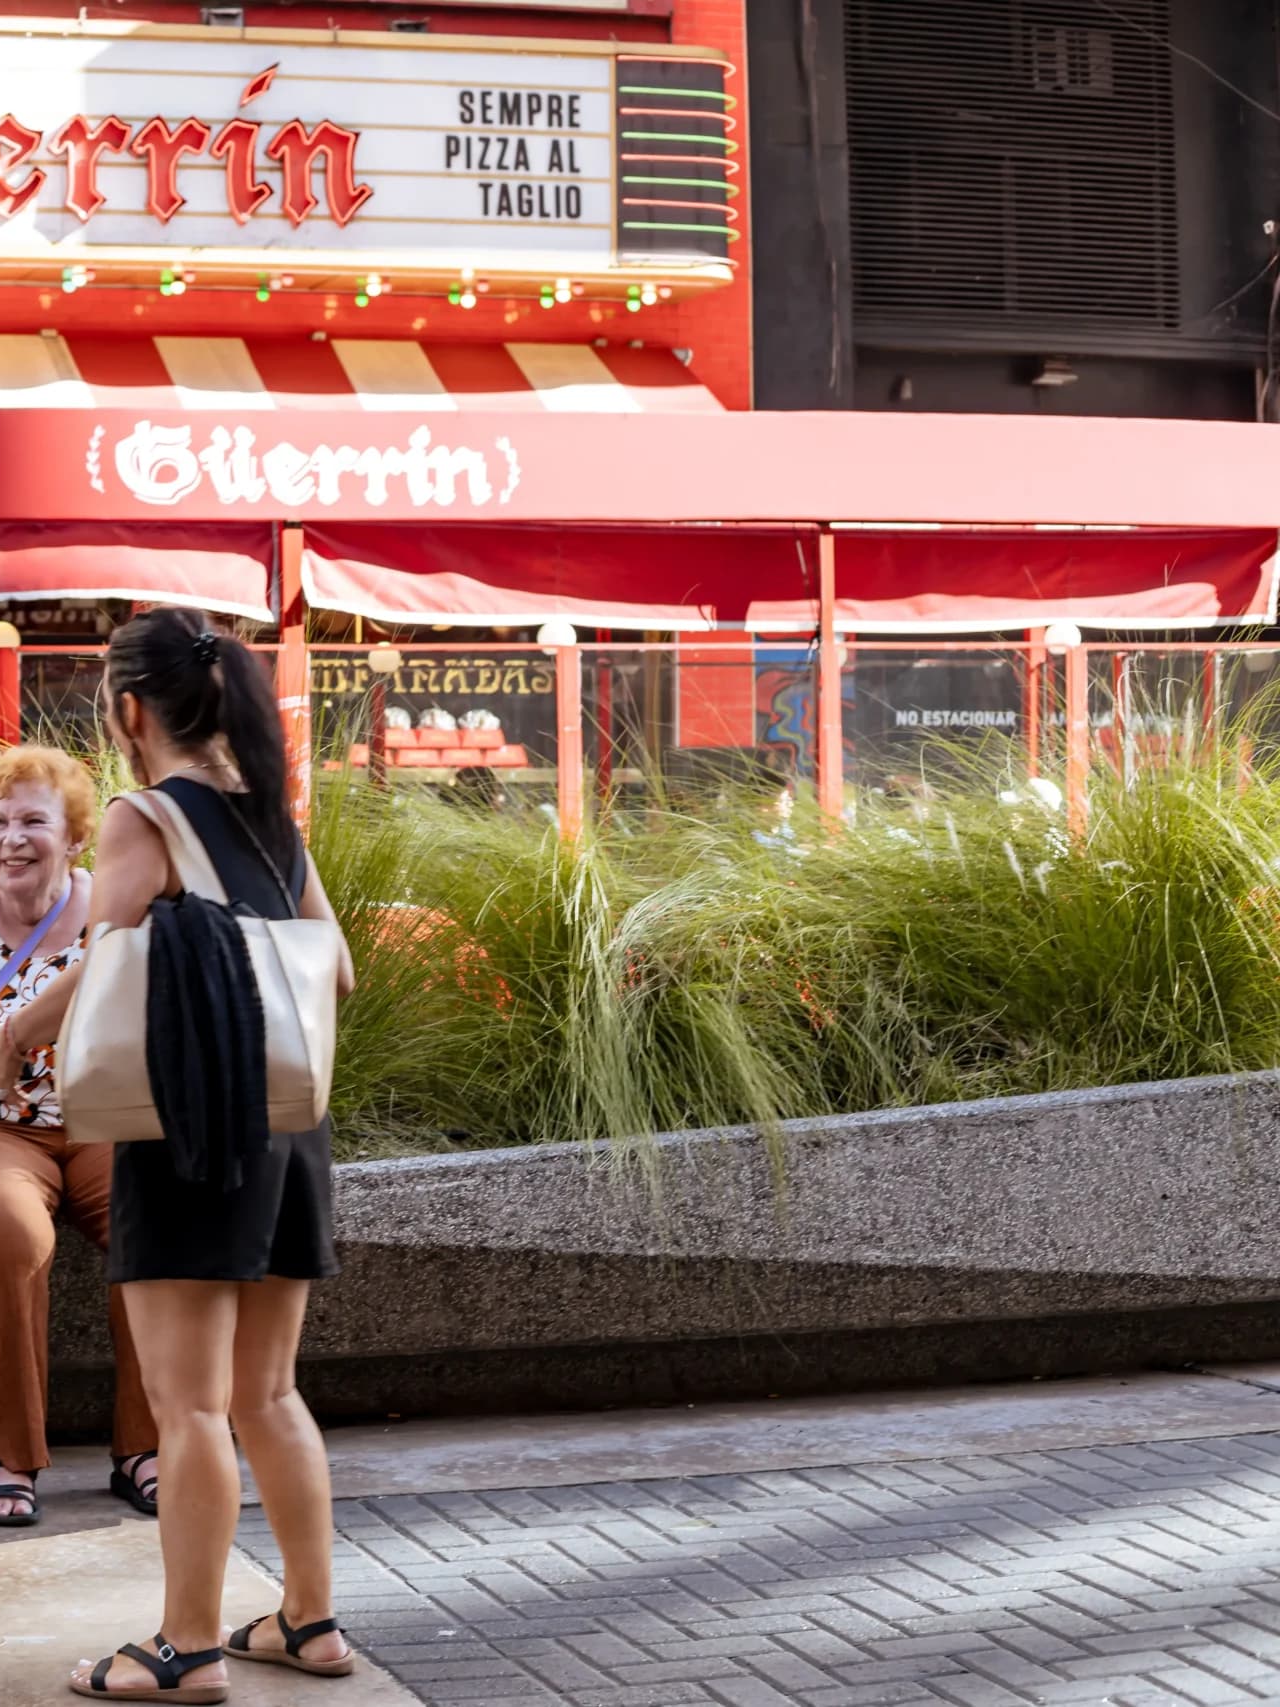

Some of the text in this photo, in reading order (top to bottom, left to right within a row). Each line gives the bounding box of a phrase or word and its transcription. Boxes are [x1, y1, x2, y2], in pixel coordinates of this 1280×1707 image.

[458, 90, 582, 129] SEMPRE
[445, 134, 582, 174] PIZZA AL
[477, 181, 582, 220] TAGLIO
[895, 710, 1017, 727] NO ESTACIONAR
